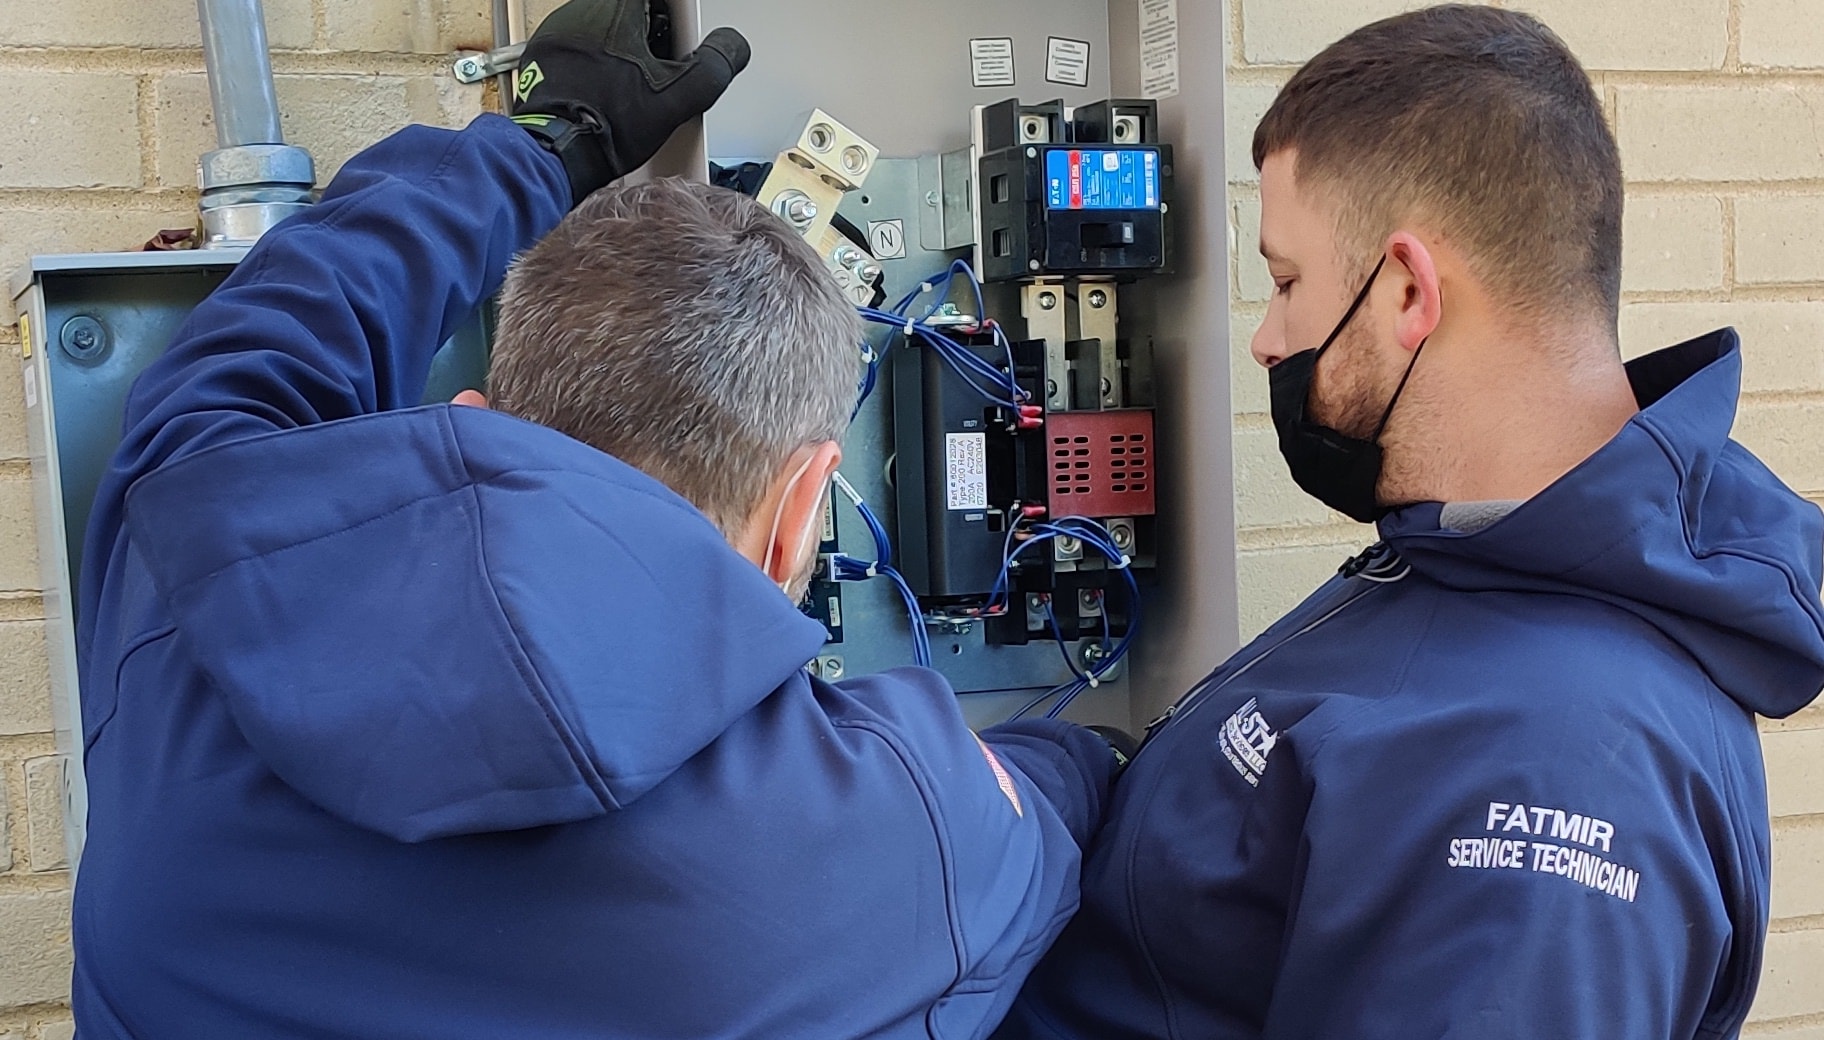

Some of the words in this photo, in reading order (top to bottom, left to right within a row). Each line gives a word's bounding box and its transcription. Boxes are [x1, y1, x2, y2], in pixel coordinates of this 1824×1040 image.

[880, 229, 893, 249] N
[959, 485, 968, 507] Type
[1486, 801, 1615, 853] FATMIR
[1448, 838, 1526, 868] SERVICE
[1532, 843, 1639, 902] TECHNICIAN
